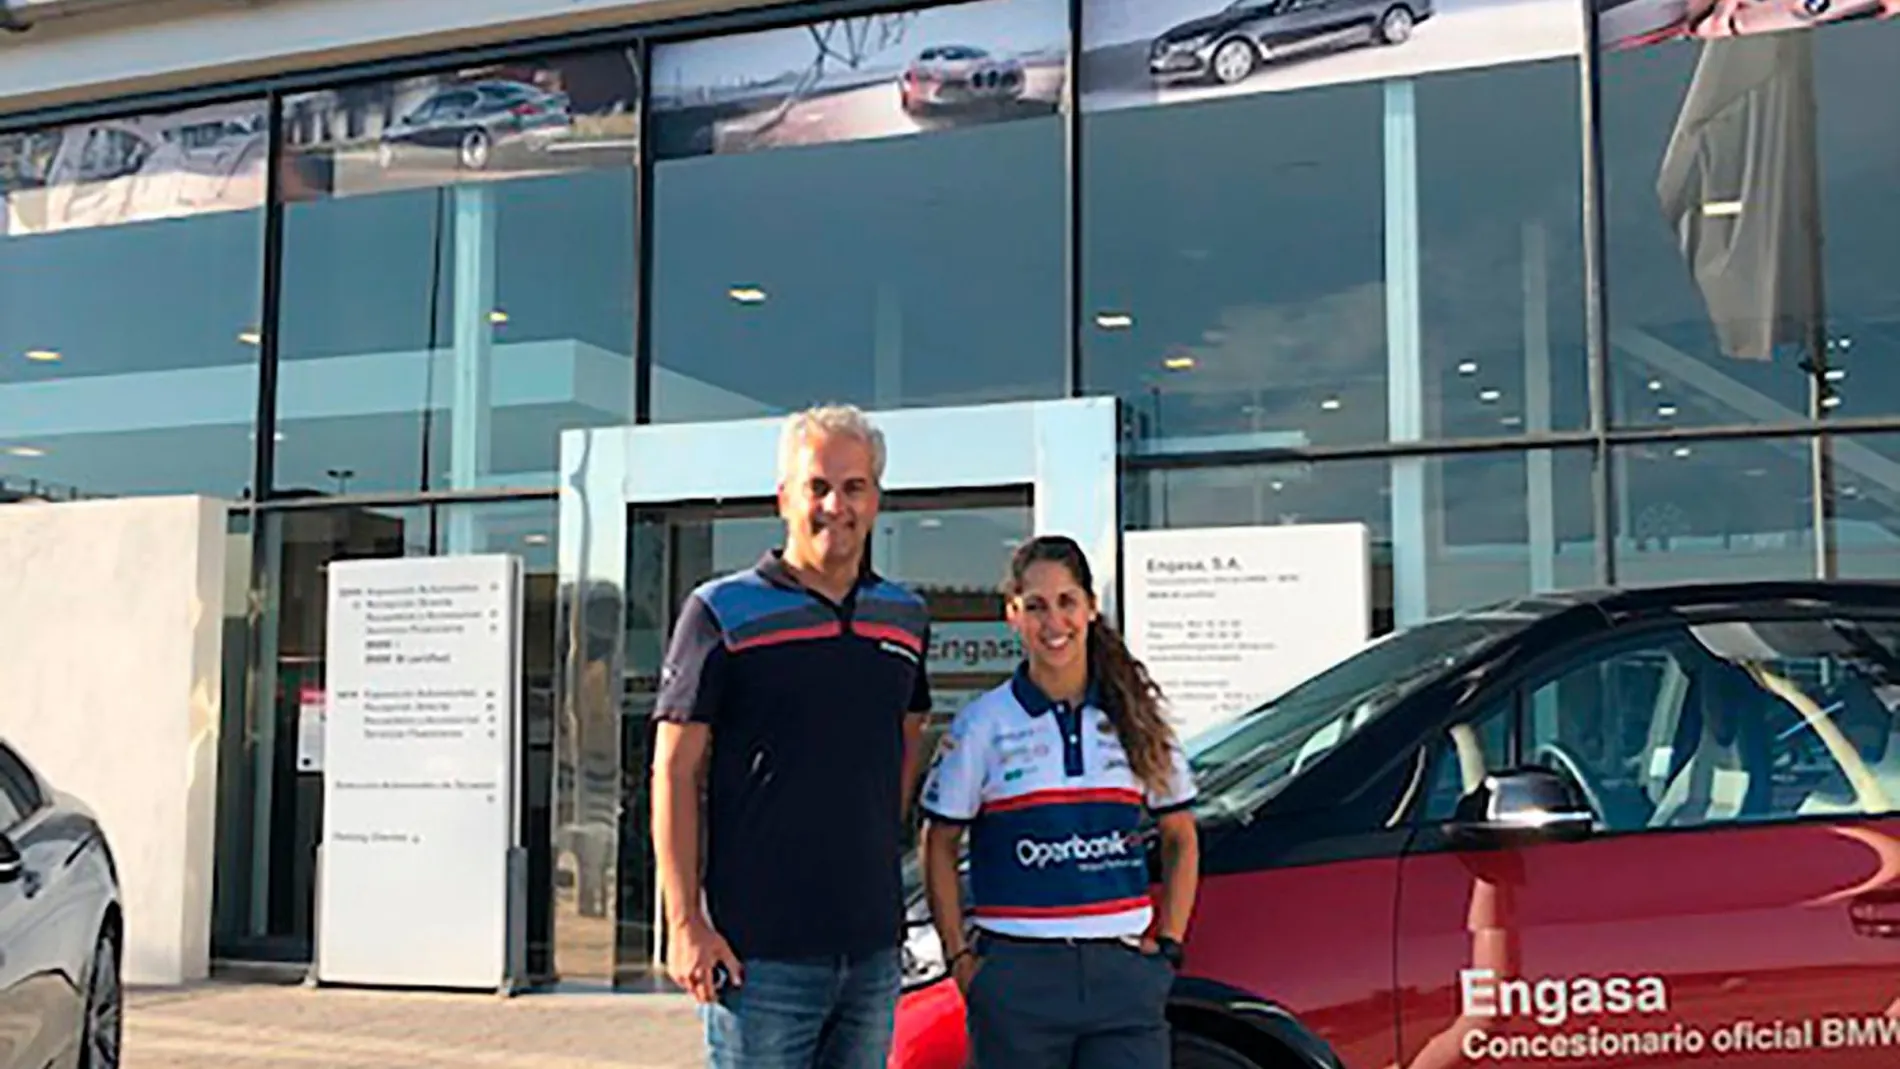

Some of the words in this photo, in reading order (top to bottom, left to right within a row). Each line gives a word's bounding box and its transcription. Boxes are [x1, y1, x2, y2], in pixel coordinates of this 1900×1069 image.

[928, 632, 1021, 665] Engas
[1460, 969, 1667, 1025] Engasa
[1462, 1025, 1704, 1059] Concesionario
[1711, 1019, 1812, 1051] oficial
[1820, 1016, 1900, 1048] BMW
